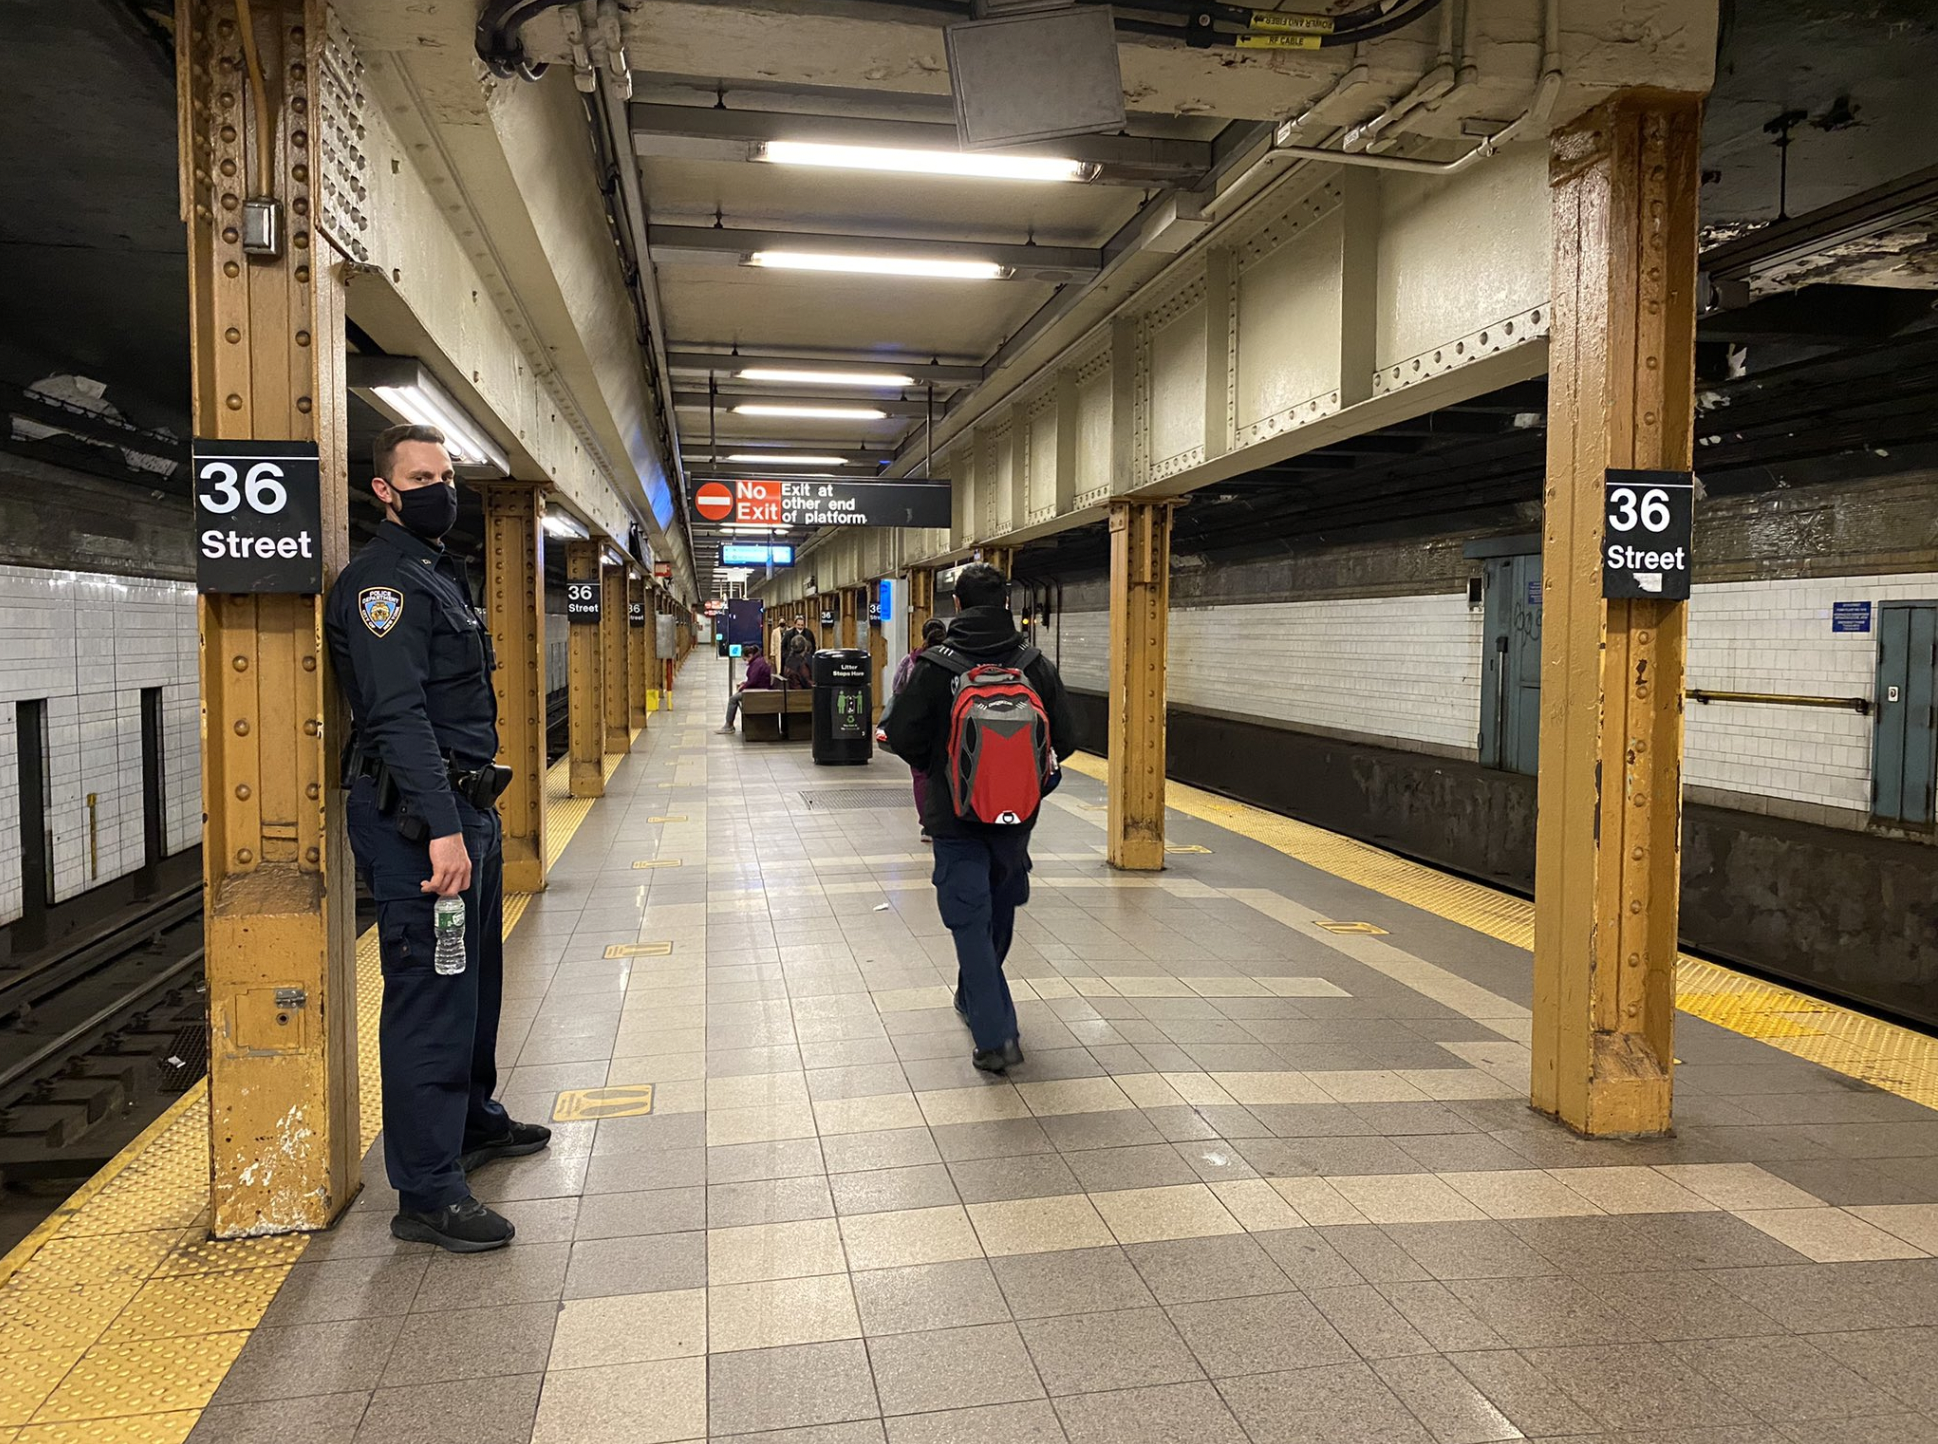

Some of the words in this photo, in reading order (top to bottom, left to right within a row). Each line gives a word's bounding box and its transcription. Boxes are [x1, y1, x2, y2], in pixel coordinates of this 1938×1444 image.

[1280, 36, 1304, 46] CABLE
[199, 461, 287, 515] 36
[737, 482, 767, 499] No
[781, 483, 811, 497] Exit
[818, 484, 834, 497] at
[782, 497, 820, 510] other
[828, 498, 855, 511] end
[1608, 487, 1671, 533] 36
[737, 503, 778, 521] Exit
[782, 510, 798, 523] of
[805, 510, 866, 525] platform
[201, 529, 313, 559] Street
[1607, 544, 1686, 570] Street
[568, 585, 592, 600] 36
[568, 603, 599, 613] Street
[869, 604, 882, 614] 36
